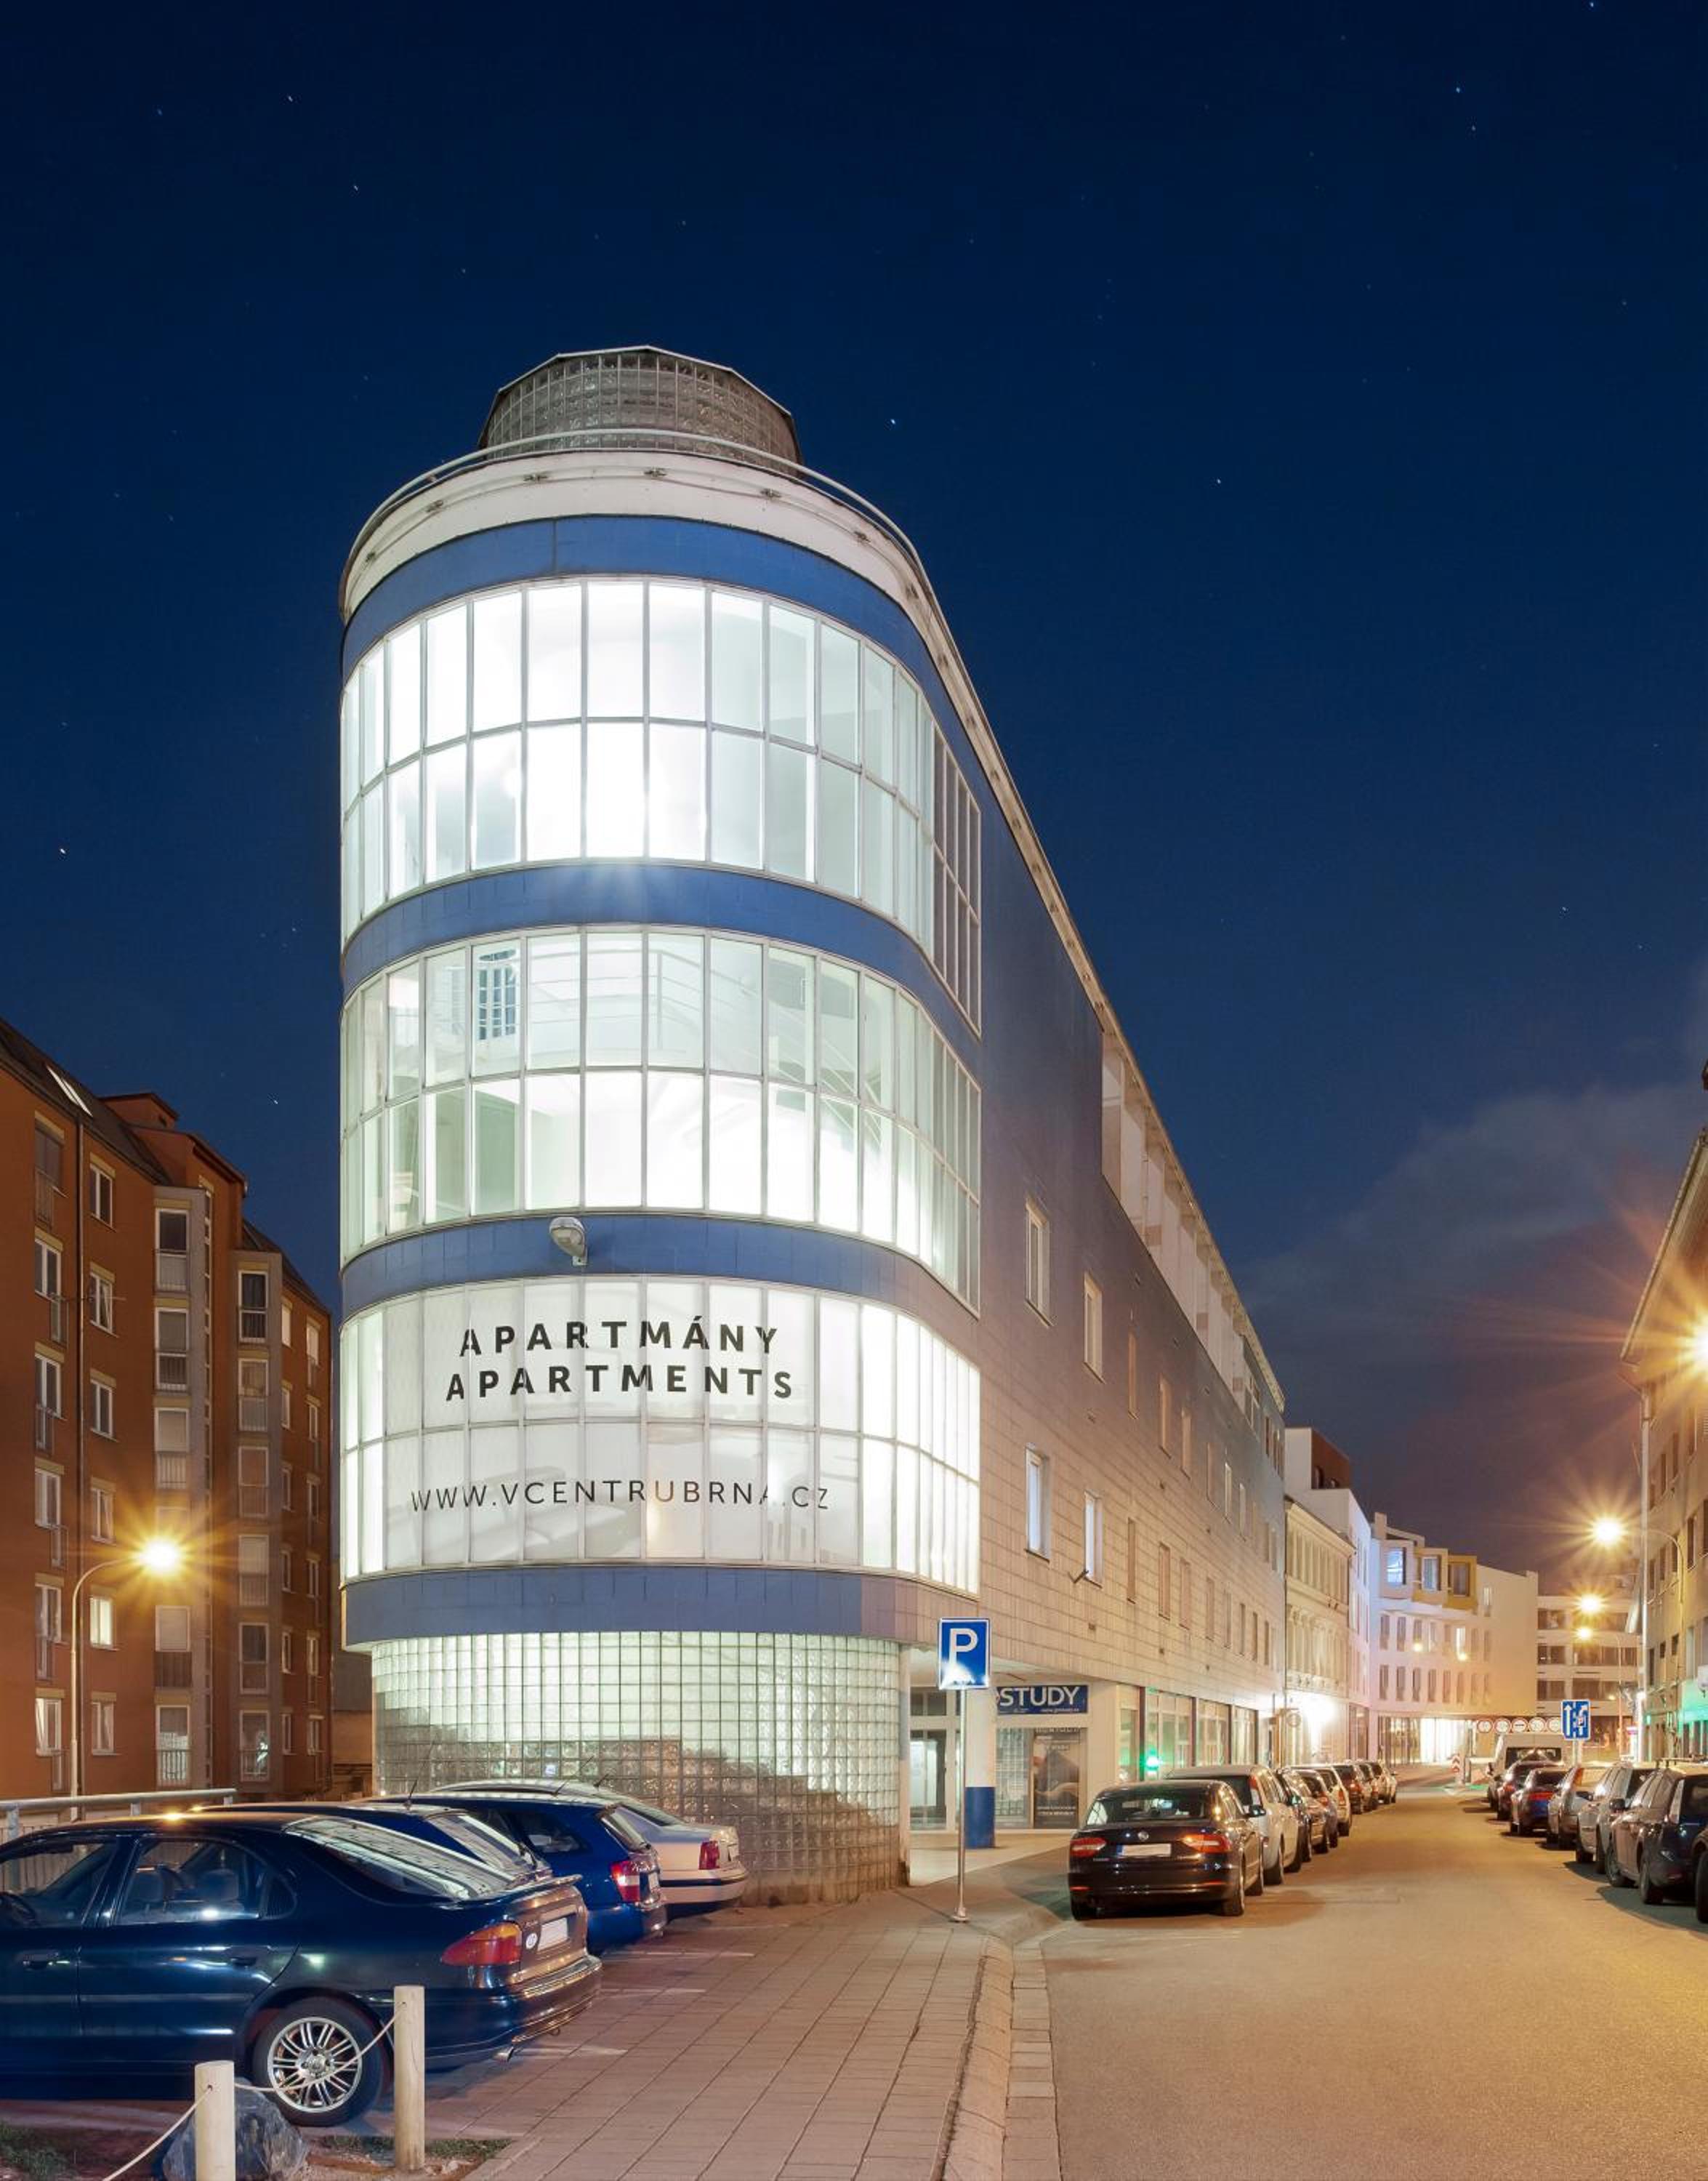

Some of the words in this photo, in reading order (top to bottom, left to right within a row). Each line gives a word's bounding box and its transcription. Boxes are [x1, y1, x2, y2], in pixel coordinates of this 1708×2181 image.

[459, 1315, 778, 1358] APARTMÁNY
[446, 1364, 792, 1402] APARTMENTS
[948, 1628, 978, 1666] P
[996, 1685, 1081, 1707] STUDY
